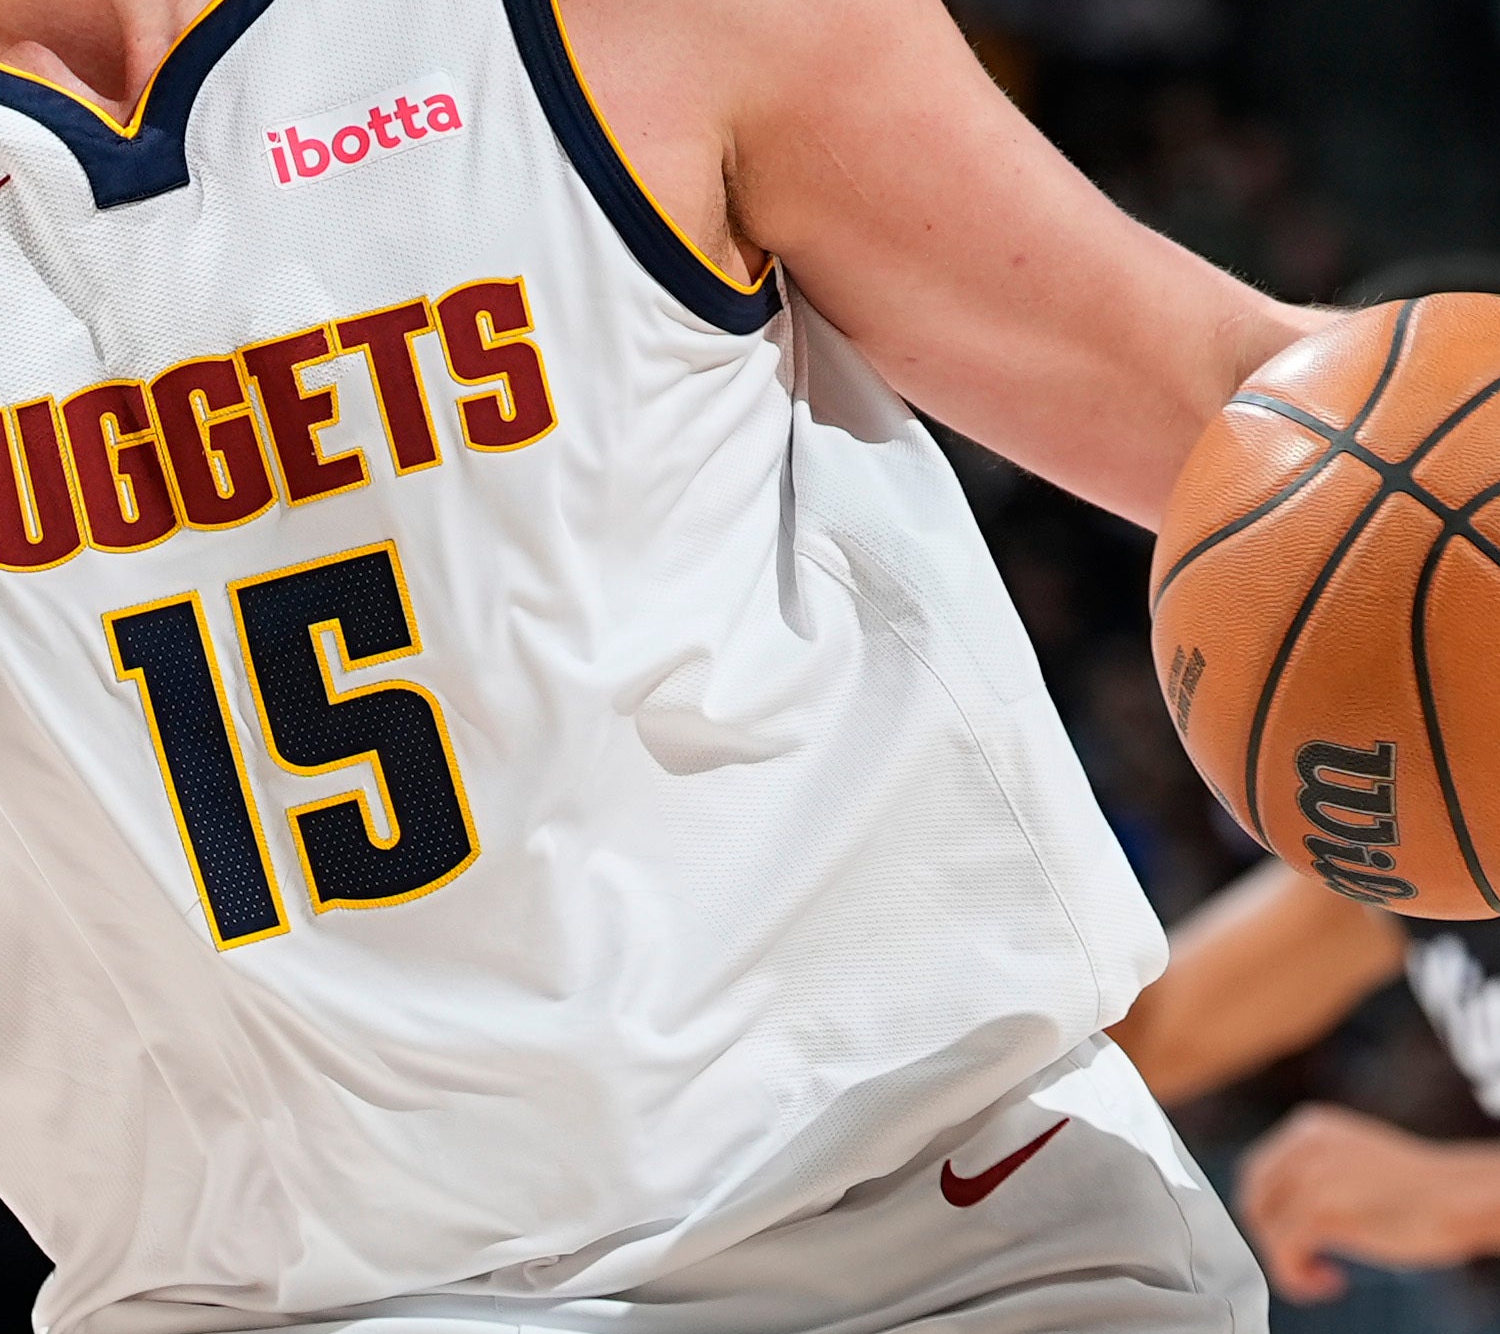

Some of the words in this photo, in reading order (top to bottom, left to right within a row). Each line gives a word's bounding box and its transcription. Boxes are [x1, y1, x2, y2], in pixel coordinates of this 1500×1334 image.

[266, 93, 463, 185] ibotta
[101, 538, 481, 952] 15
[1294, 739, 1420, 907] Wil
